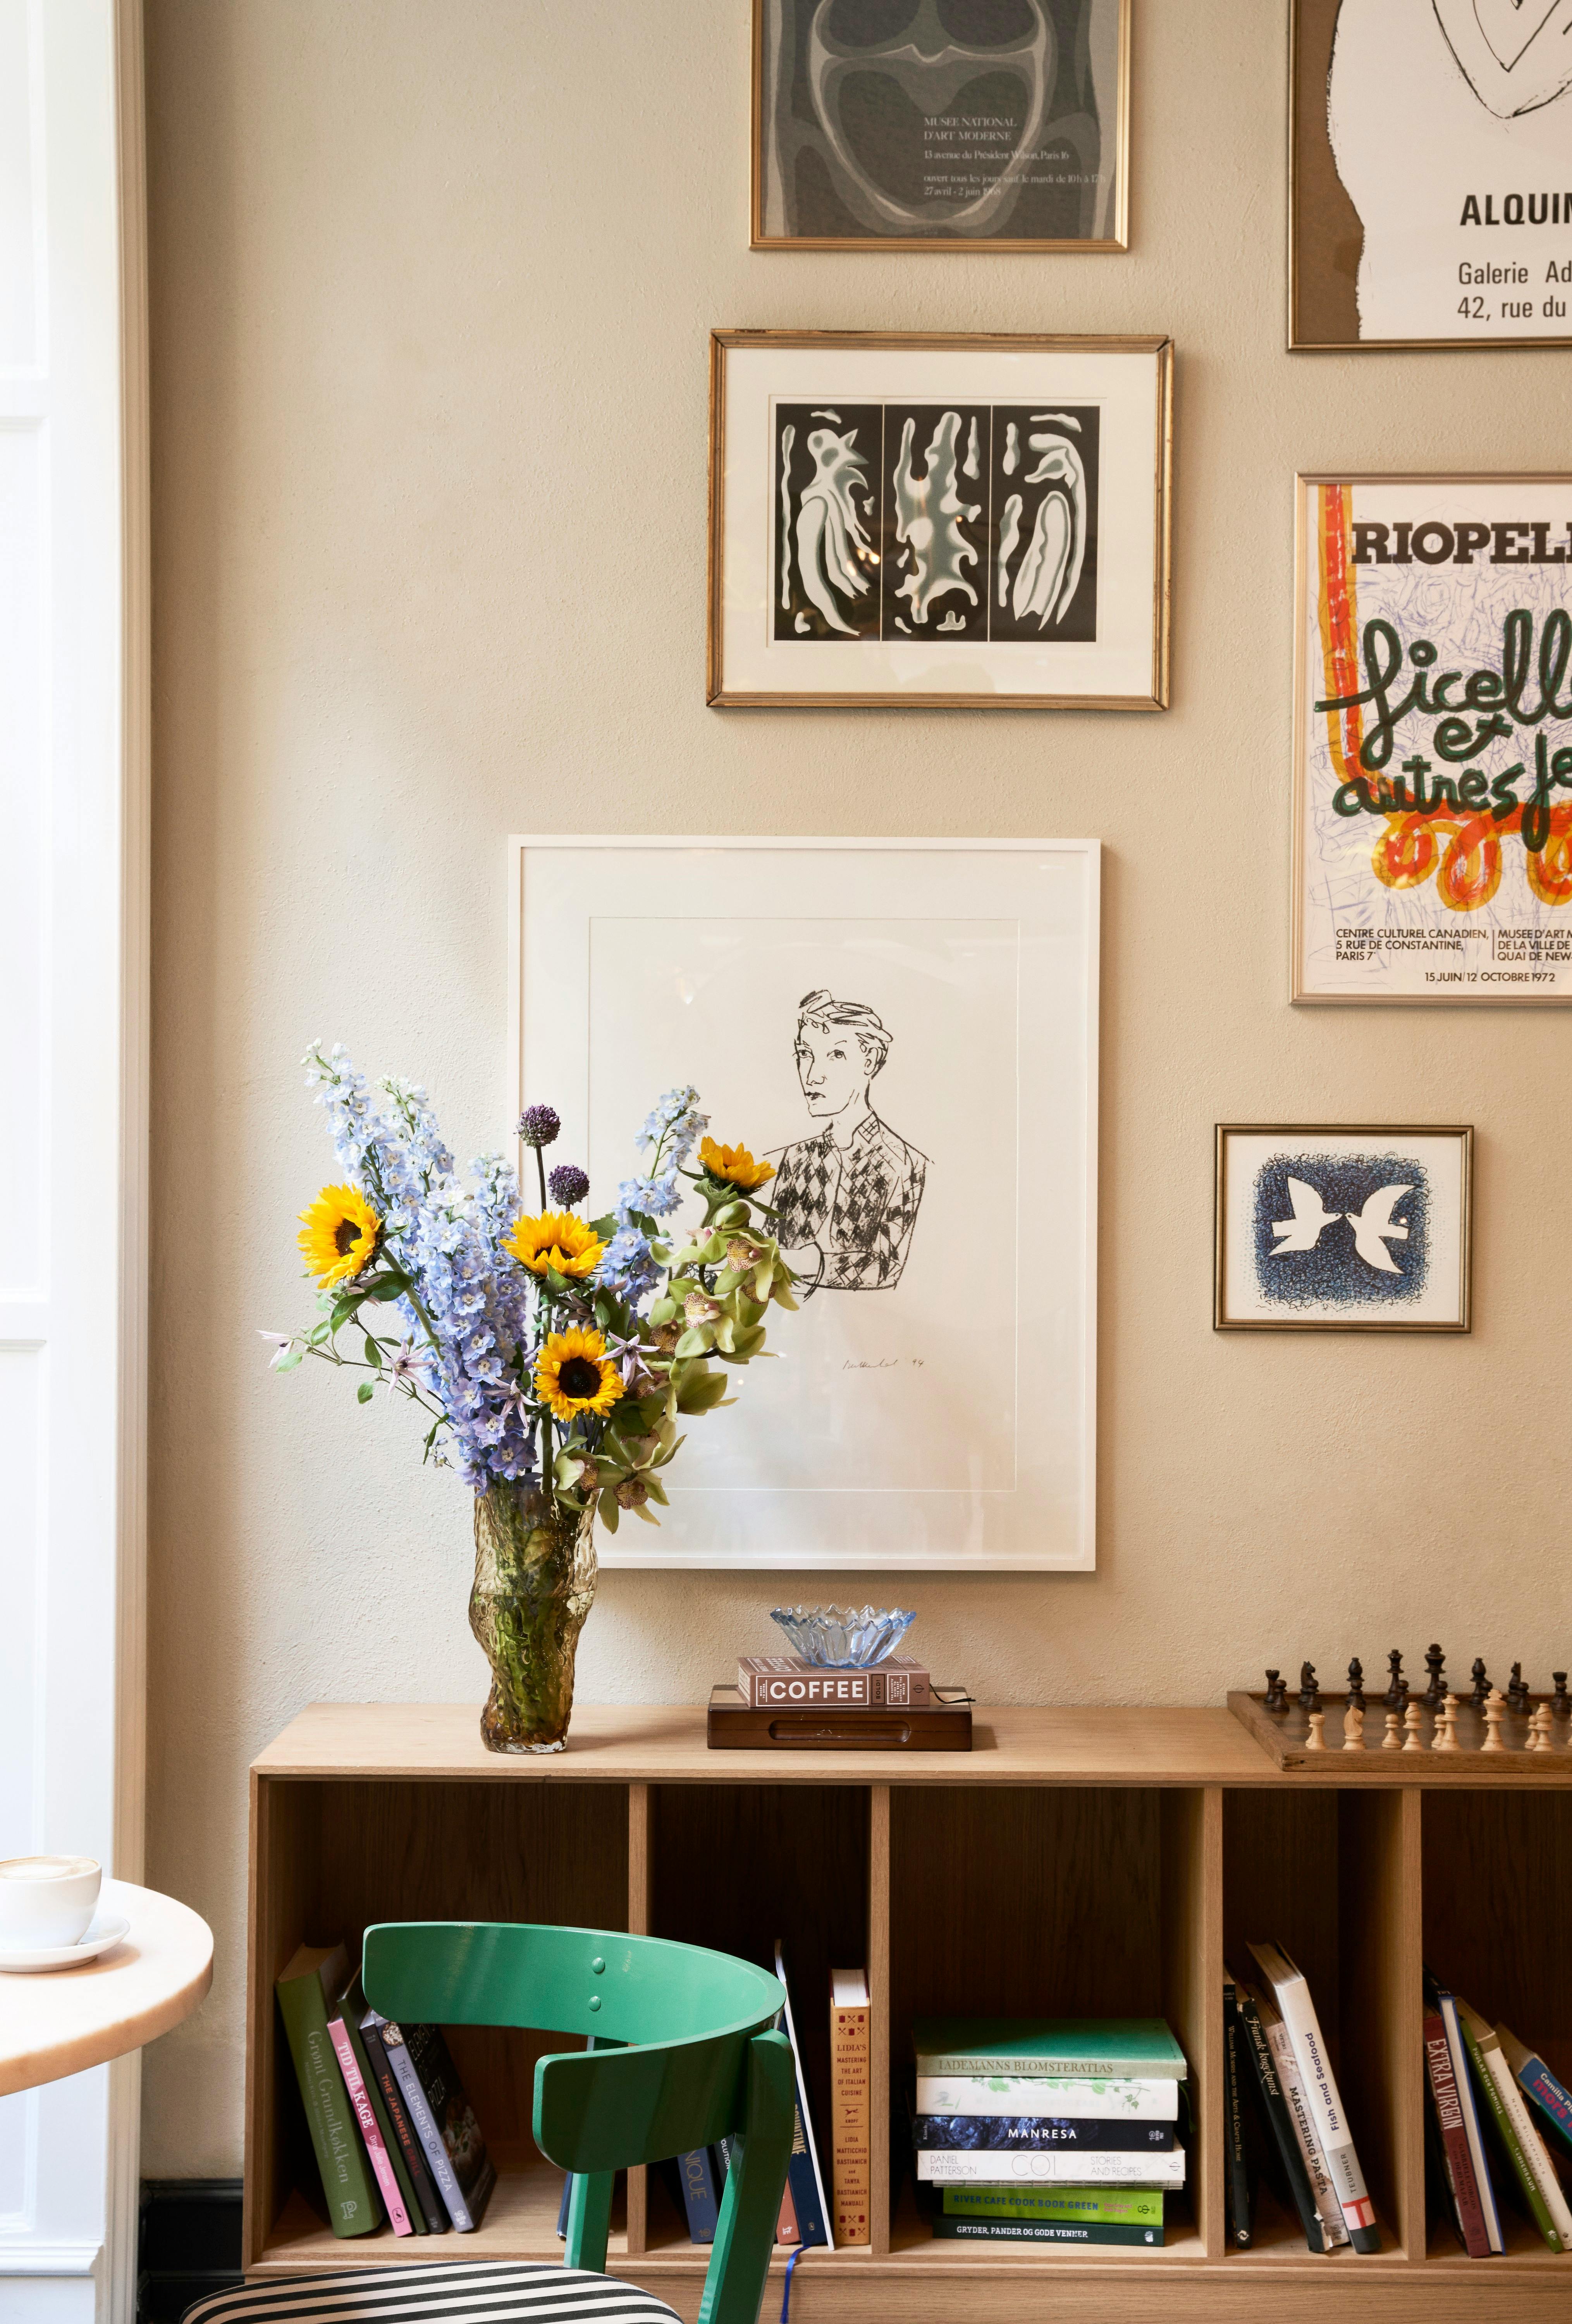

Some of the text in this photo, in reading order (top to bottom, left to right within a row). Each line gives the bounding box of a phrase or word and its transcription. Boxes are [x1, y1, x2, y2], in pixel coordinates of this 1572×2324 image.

[924, 117, 1017, 126] MUSEE NATIONAL
[924, 131, 1011, 141] D'ART MODERNE
[962, 150, 972, 159] du
[1041, 151, 1059, 159] Paris
[970, 174, 980, 182] les
[982, 174, 1001, 185] jours
[1022, 174, 1029, 182] le
[1031, 174, 1053, 183] mardi
[1056, 174, 1065, 183] de
[924, 186, 980, 198] 27 avril 2 juin
[1458, 261, 1528, 285] Galerie
[1457, 295, 1566, 321] 42, rue du
[1352, 521, 1572, 564] RIOPEL
[1314, 608, 1572, 771] ficell
[1434, 713, 1514, 762] et
[1336, 929, 1489, 940] CENTRE CULTUREL CANADIEN,
[1498, 930, 1565, 938] MUSEE D'ART
[1336, 940, 1464, 951] 5 RUE DE CONSTANTINE,
[1498, 941, 1570, 949] DE LA VILLE DE
[1336, 951, 1364, 960] PARIS
[1498, 952, 1542, 961] QUAI DE
[1425, 972, 1555, 982] 15 OCTOBRE 1972
[765, 1658, 792, 1671] COFFEE
[770, 1680, 864, 1699] COFFEE
[1245, 2016, 1280, 2095] Fransk kogekunst
[939, 2060, 1113, 2073] LADEMANNS BLOMSTERATLAS
[337, 2042, 374, 2128] TID TIL KAGE
[1305, 2033, 1339, 2131] Fish and Seafood
[1427, 2038, 1463, 2130] EXTRA VIRGIN
[1541, 2073, 1564, 2101] Camilla
[1483, 2074, 1492, 2087] OCH
[1489, 2088, 1503, 2114] POMMES
[1532, 2079, 1568, 2119] mors
[1512, 2098, 1523, 2122] NANCY
[381, 2074, 421, 2177] THE JAPANESE GRILL
[397, 2059, 453, 2192] THE ELEMENTS OF PIZZA
[1008, 2129, 1077, 2139] MANRESA
[1289, 2086, 1328, 2195] MASTERING PASTA
[369, 2135, 378, 2150] Ditte
[375, 2150, 383, 2165] Julie
[930, 2156, 959, 2164] DANIEL
[1011, 2154, 1056, 2176] COI
[1090, 2156, 1122, 2165] STORIES
[930, 2166, 976, 2175] PATTERSON
[1090, 2167, 1142, 2177] AND RECIPES
[1340, 2154, 1356, 2194] TEUBNER
[954, 2195, 1098, 2211] RIVER CAFE COOK BOOK GREEN
[957, 2226, 989, 2234] GRYDER,
[991, 2227, 1022, 2235] PANDER
[1056, 2229, 1088, 2238] VENNER
